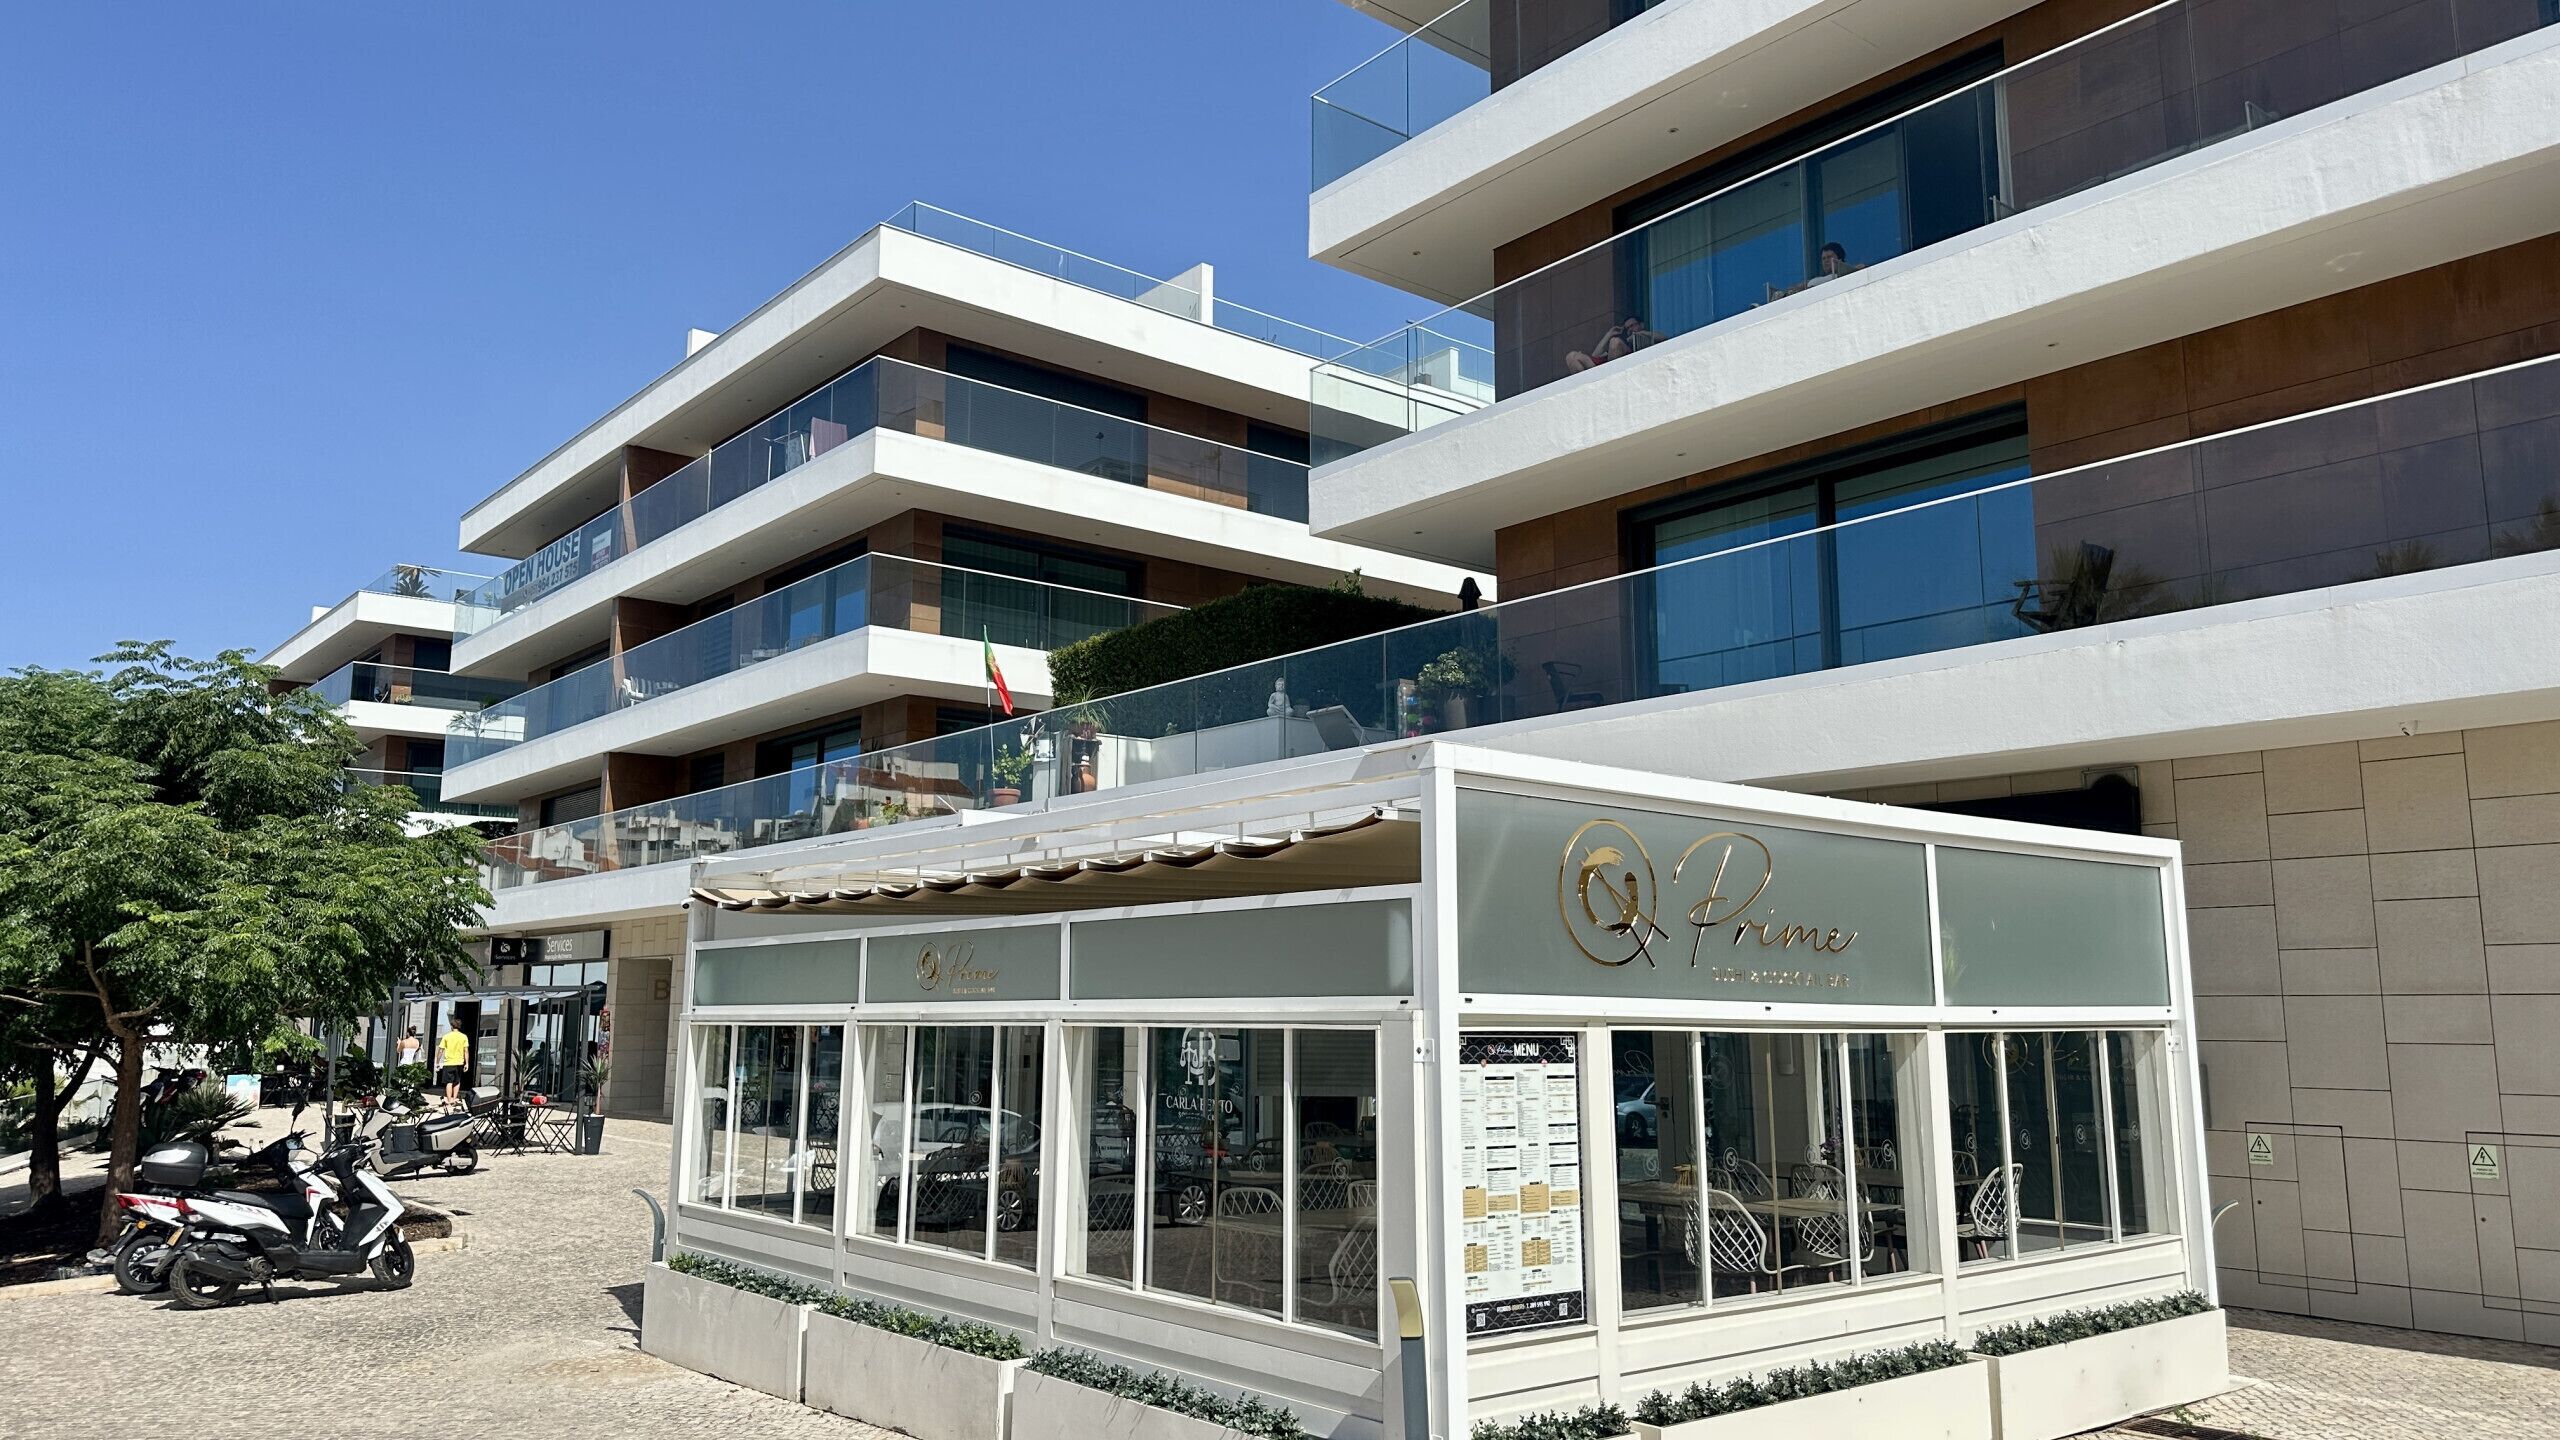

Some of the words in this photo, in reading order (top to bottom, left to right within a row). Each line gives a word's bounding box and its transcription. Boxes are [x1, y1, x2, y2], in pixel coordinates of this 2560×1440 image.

[504, 558, 534, 596] OPEN
[537, 532, 580, 577] HOUSE
[1673, 832, 1859, 968] Prime
[547, 936, 573, 953] Services
[945, 940, 999, 988] Prime
[1712, 966, 1746, 982] SUSHI
[1514, 1043, 1539, 1056] MENU
[1166, 1095, 1197, 1111] CARLA
